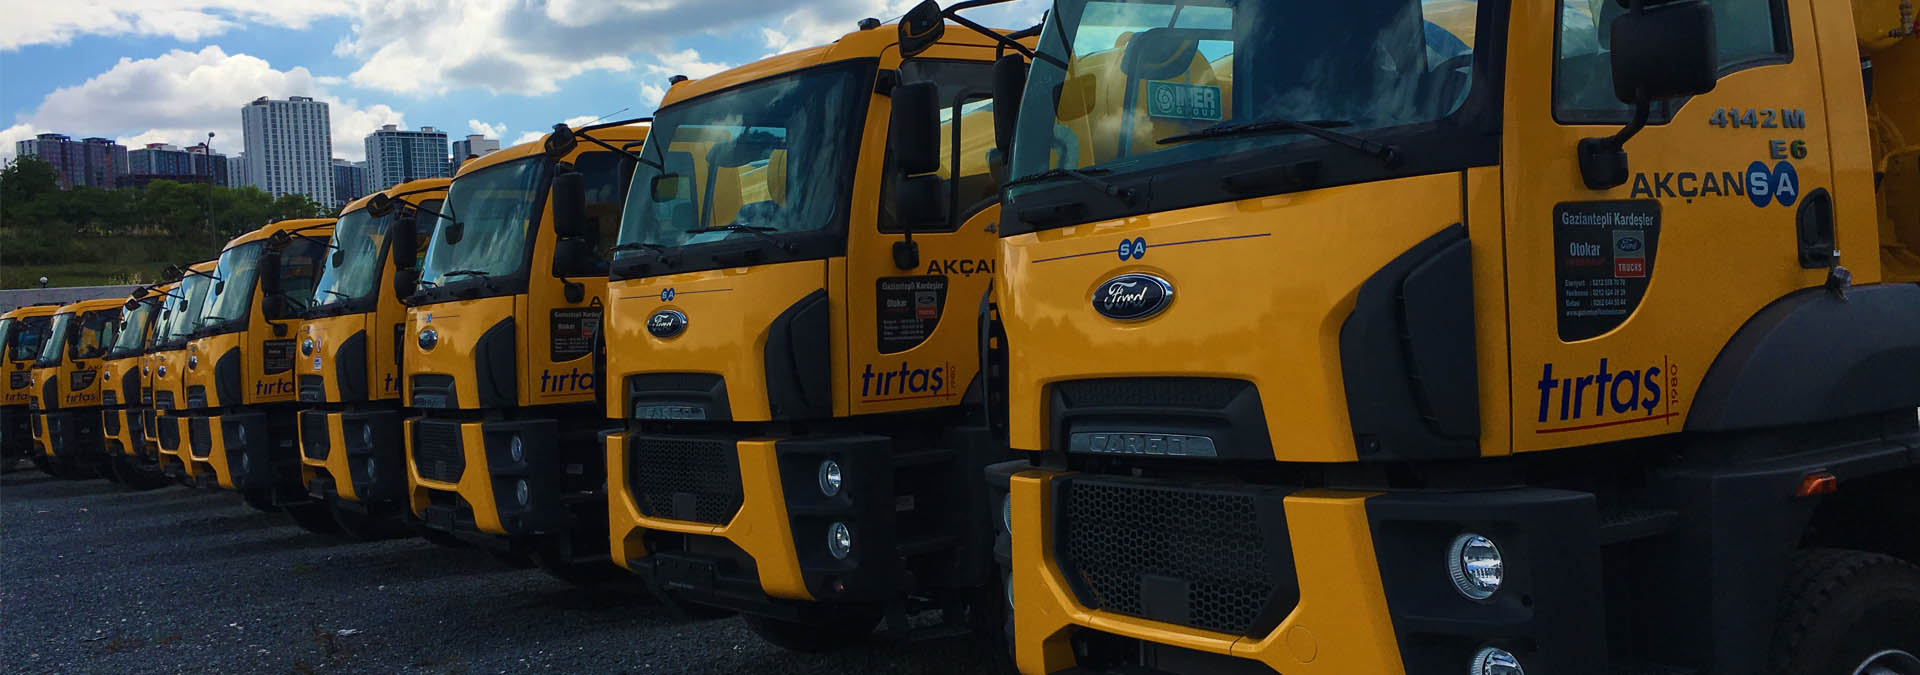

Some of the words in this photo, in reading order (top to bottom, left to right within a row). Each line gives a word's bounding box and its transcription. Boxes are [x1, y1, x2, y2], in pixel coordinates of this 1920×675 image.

[1176, 107, 1215, 117] GOUP
[1709, 109, 1777, 128] 4142
[1782, 109, 1806, 128] M
[1769, 139, 1807, 159] E6
[1562, 212, 1612, 228] Gaziantepli
[1614, 212, 1654, 228] Kardeşler
[1570, 242, 1600, 256] Otokar
[1618, 264, 1642, 272] TRUCKS
[1104, 281, 1148, 310] Ford
[256, 379, 294, 395] tırta
[541, 368, 594, 393] tırta
[862, 361, 943, 396] tırtaş
[1671, 364, 1679, 405] 1980
[1538, 357, 1661, 422] tırtaş
